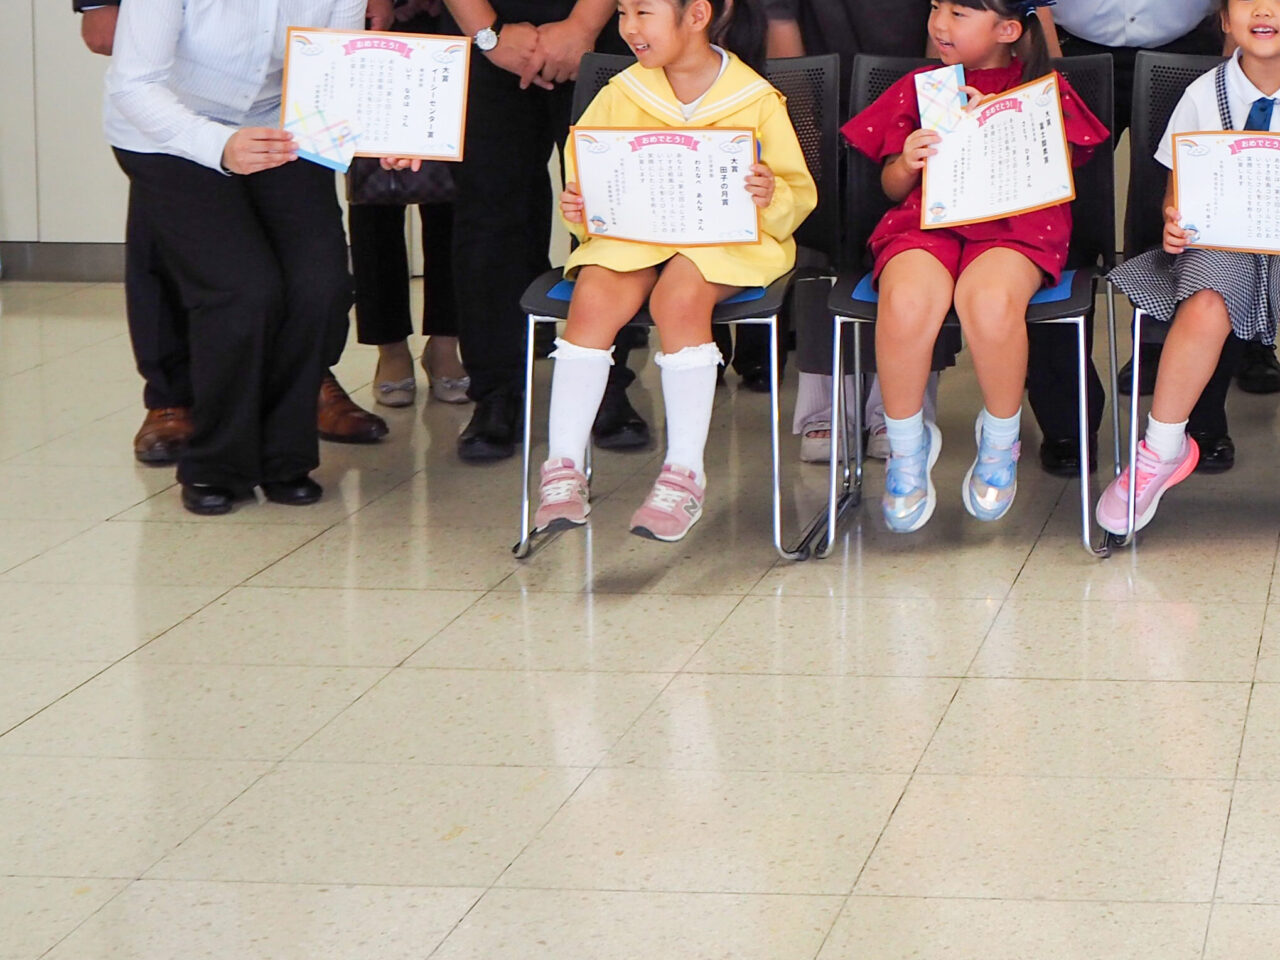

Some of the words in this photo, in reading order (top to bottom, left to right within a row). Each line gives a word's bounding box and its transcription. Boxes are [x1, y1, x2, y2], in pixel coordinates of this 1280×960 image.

[731, 158, 738, 173] 大賞
[720, 166, 729, 206] 田子の月賞
